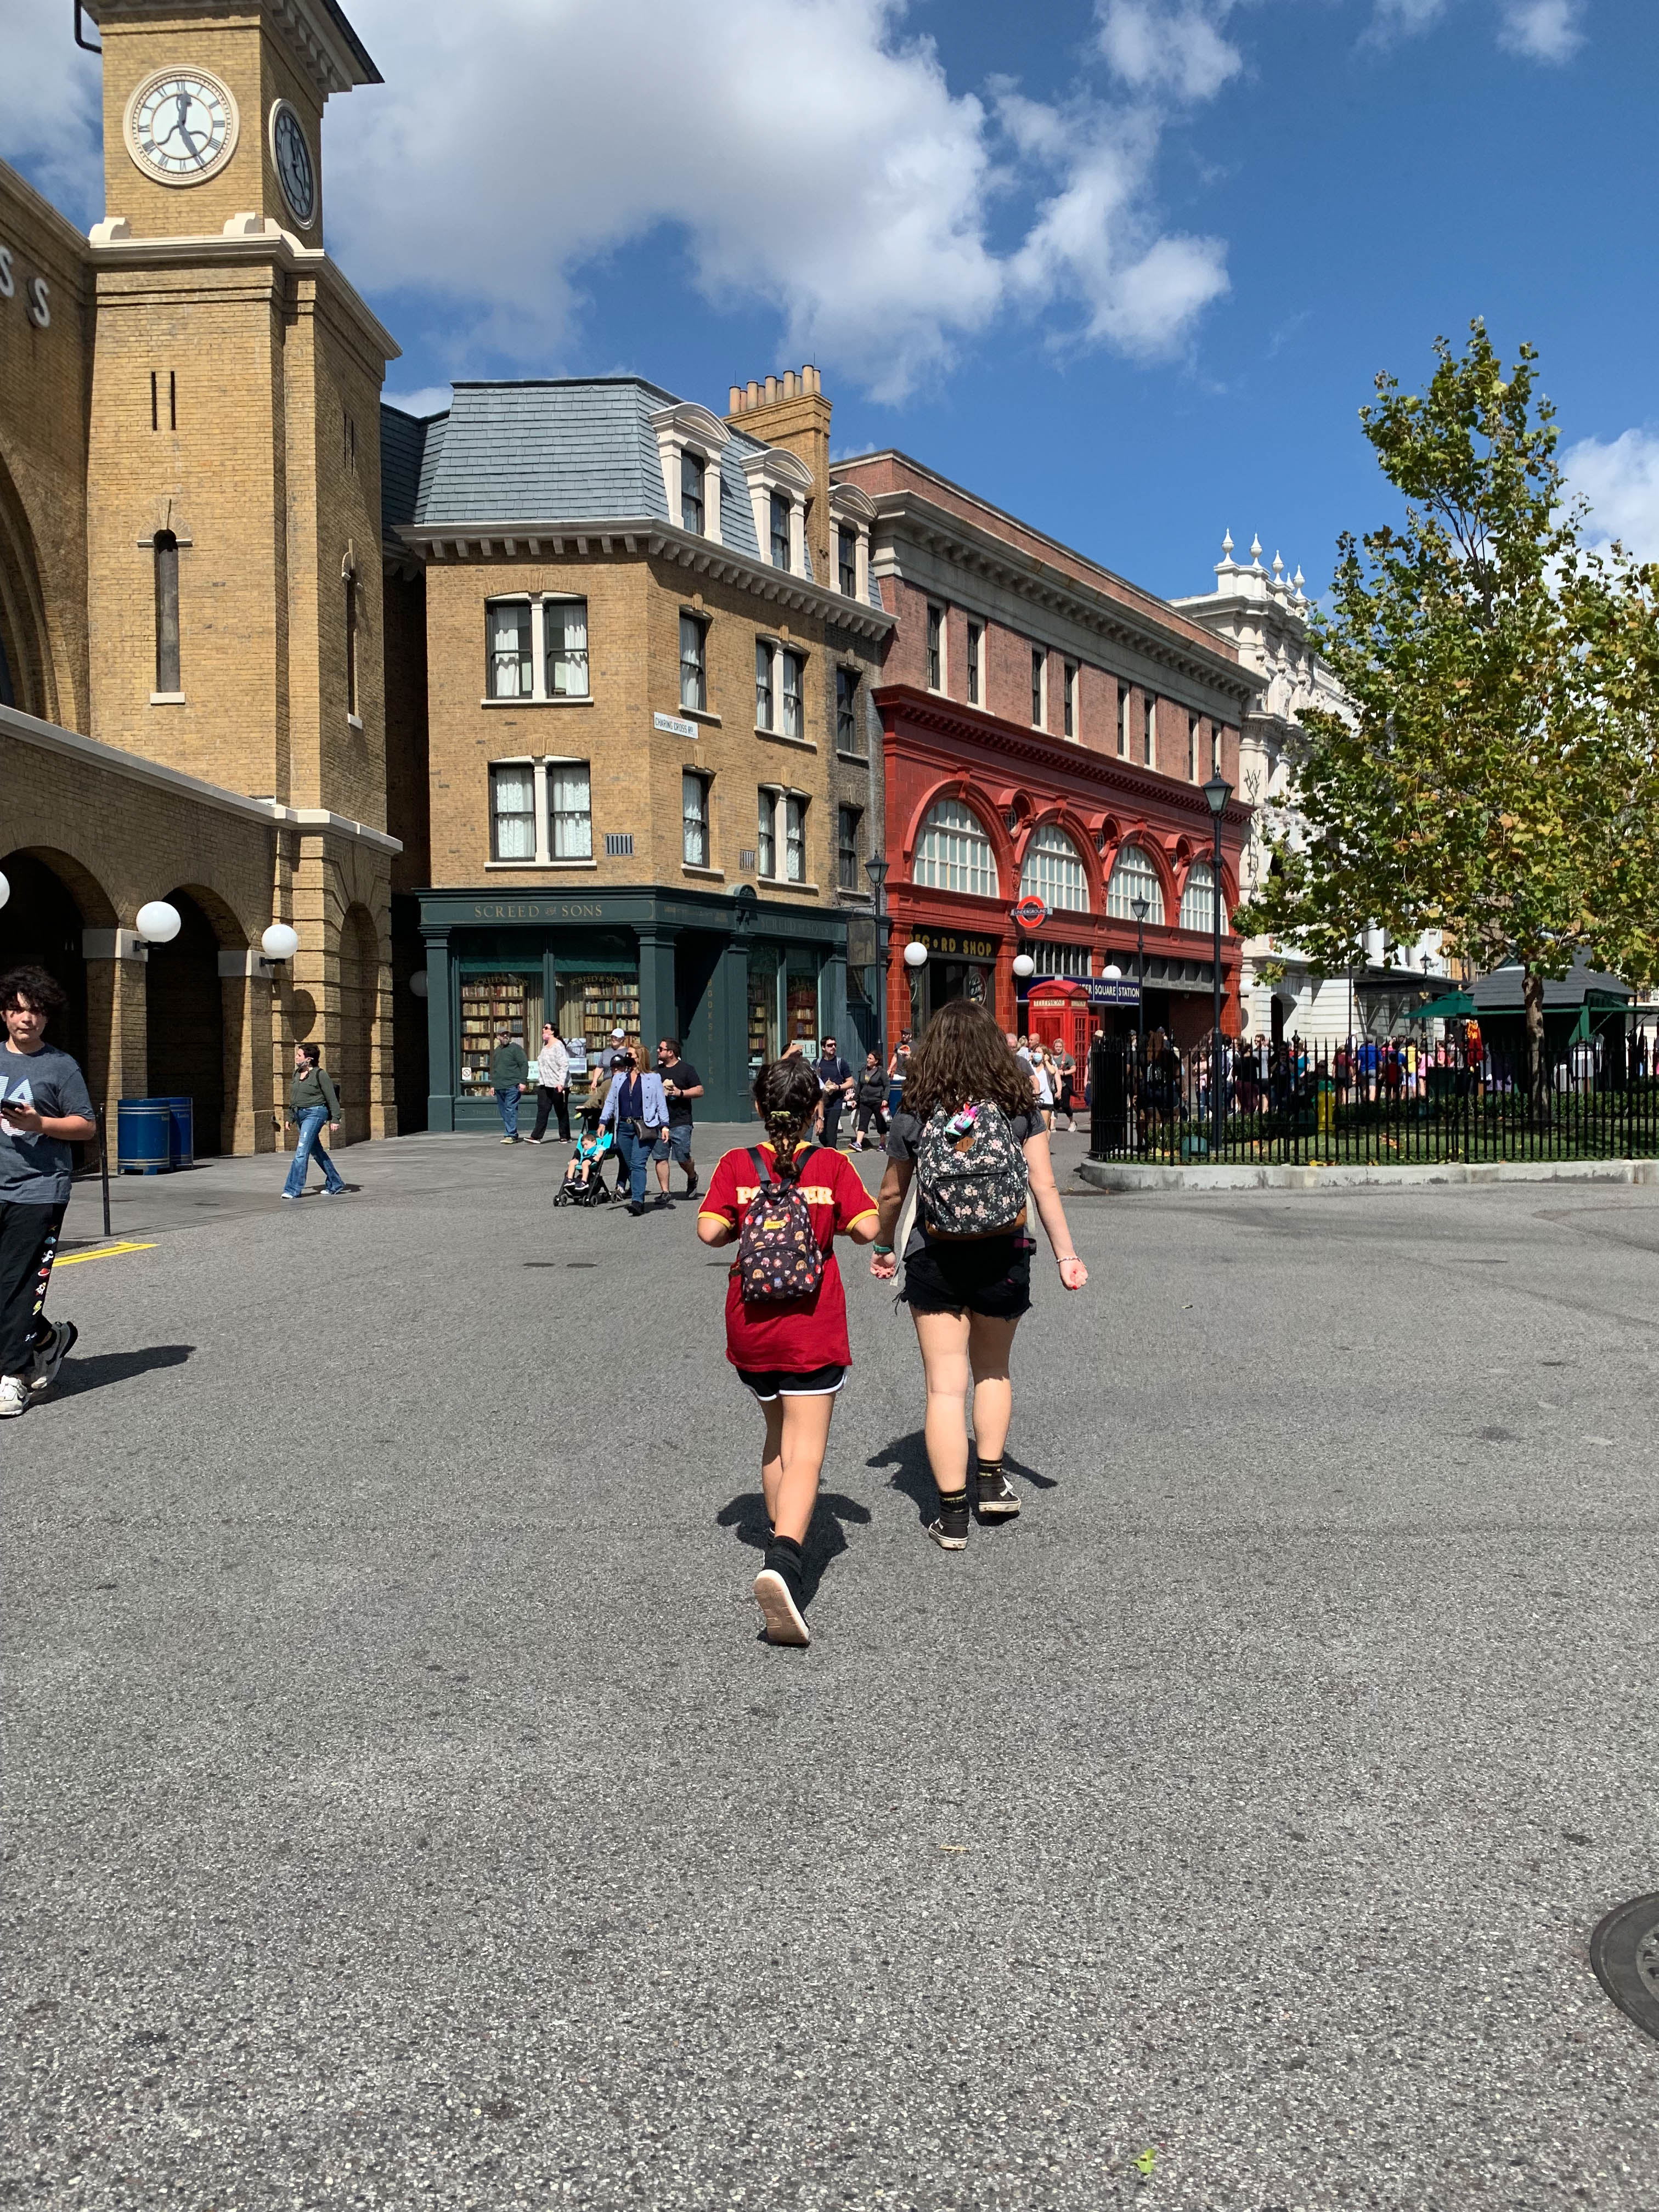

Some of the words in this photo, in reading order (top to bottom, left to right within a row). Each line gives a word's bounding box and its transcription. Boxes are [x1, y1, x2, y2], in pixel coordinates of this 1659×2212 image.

[655, 718, 673, 730] CHARING
[674, 722, 687, 733] CROSS
[475, 906, 539, 917] SCREED
[562, 905, 602, 917] SONS
[963, 940, 992, 957] SHOP
[1095, 985, 1116, 996] SQUARE
[1119, 987, 1139, 997] STATION
